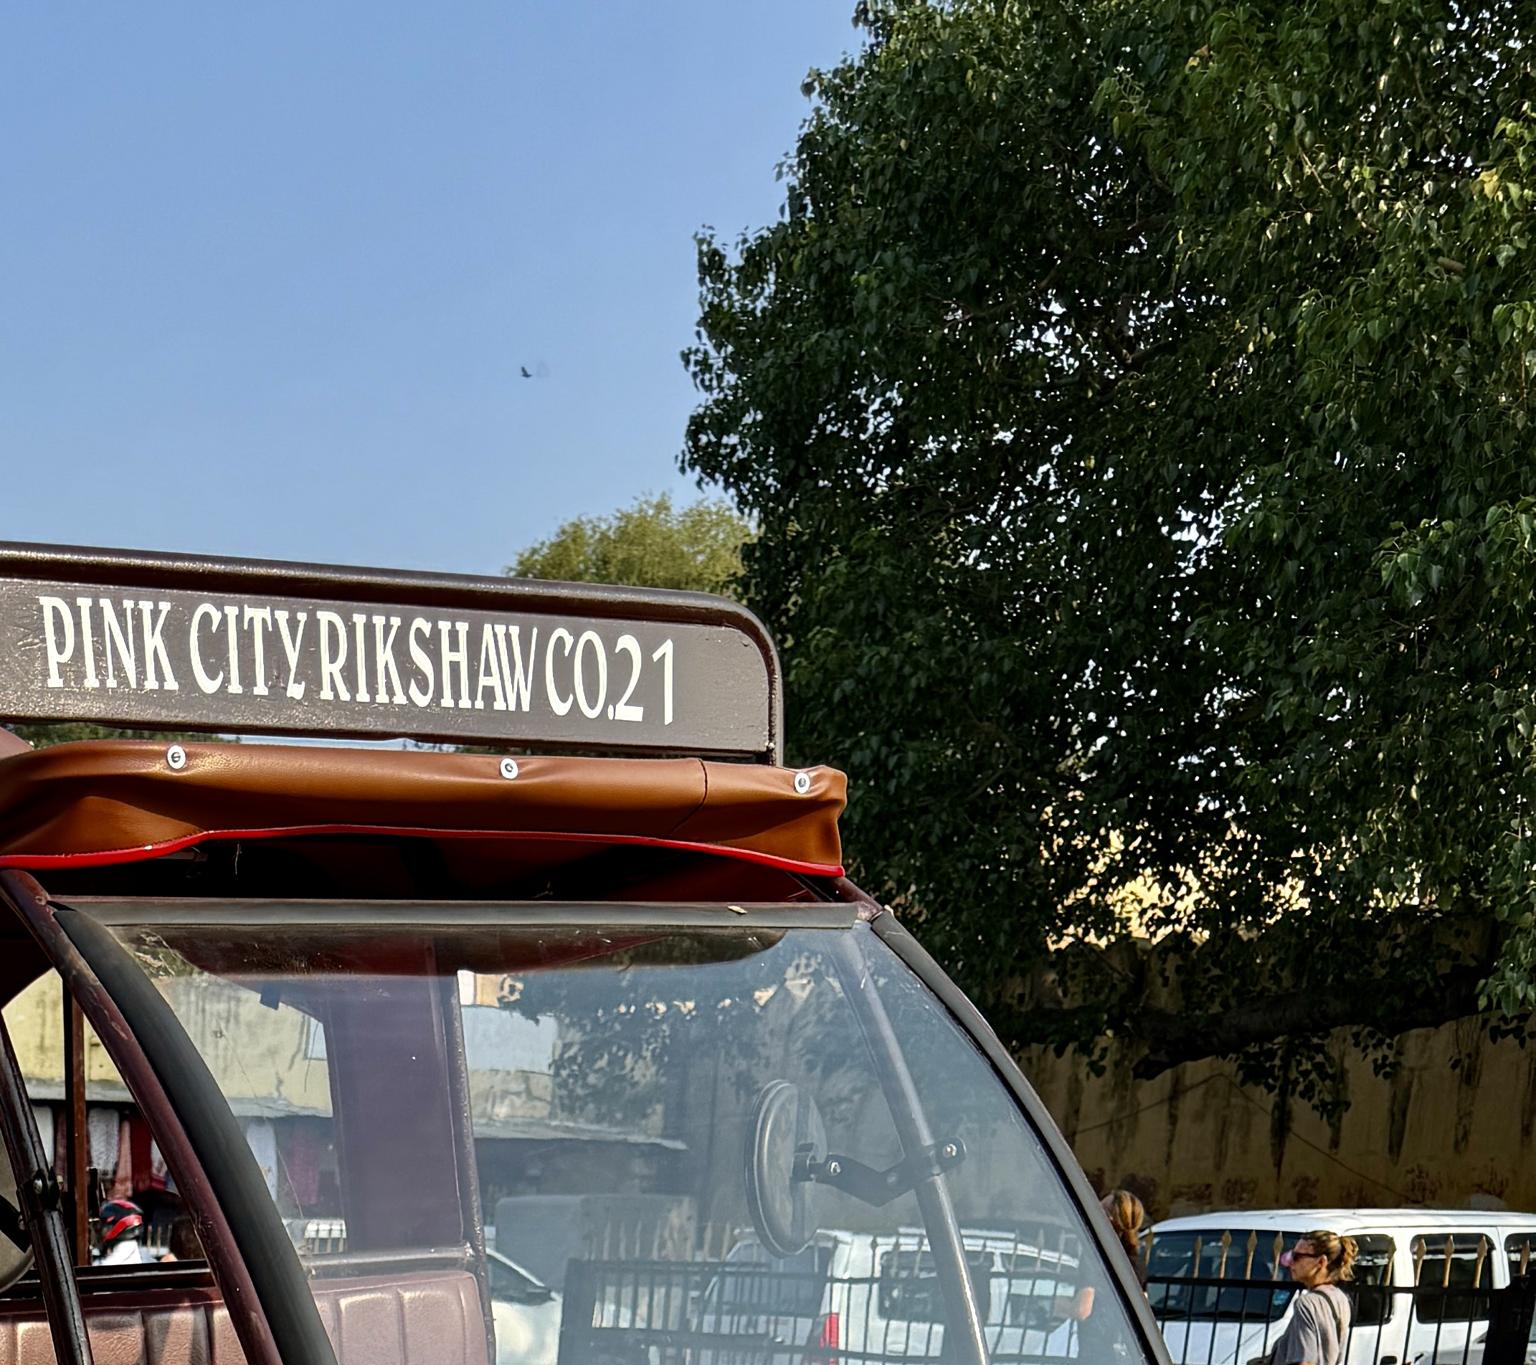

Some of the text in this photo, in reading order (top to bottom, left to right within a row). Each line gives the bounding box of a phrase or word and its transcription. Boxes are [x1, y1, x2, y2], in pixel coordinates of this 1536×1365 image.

[38, 596, 180, 691] PINK
[189, 602, 308, 700] CITY
[316, 610, 538, 713] RIKSHAW
